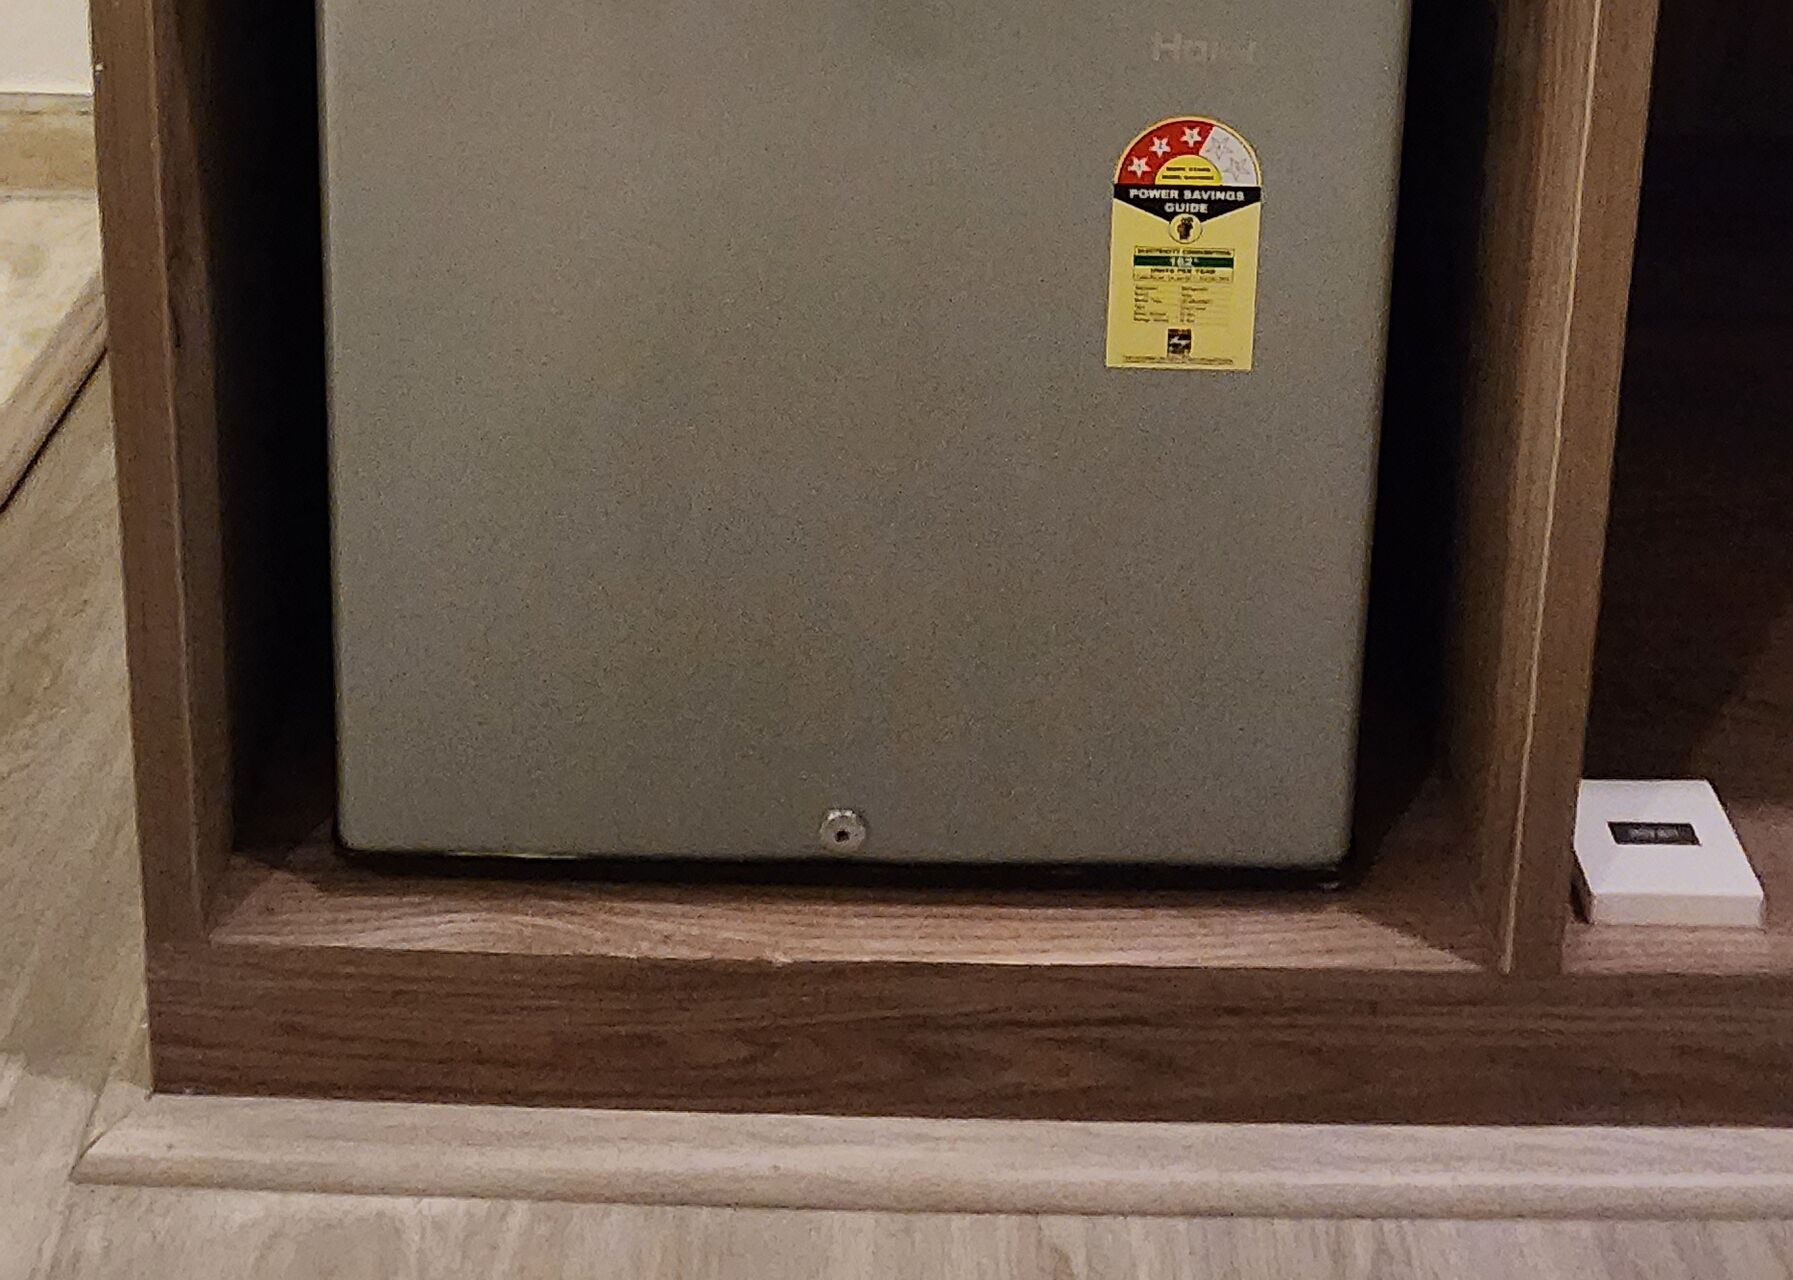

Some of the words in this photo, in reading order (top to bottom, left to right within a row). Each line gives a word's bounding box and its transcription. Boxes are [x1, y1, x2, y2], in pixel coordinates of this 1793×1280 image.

[1129, 188, 1179, 199] POWER
[1183, 189, 1245, 201] SAVINGS
[1164, 202, 1208, 213] GUIDE
